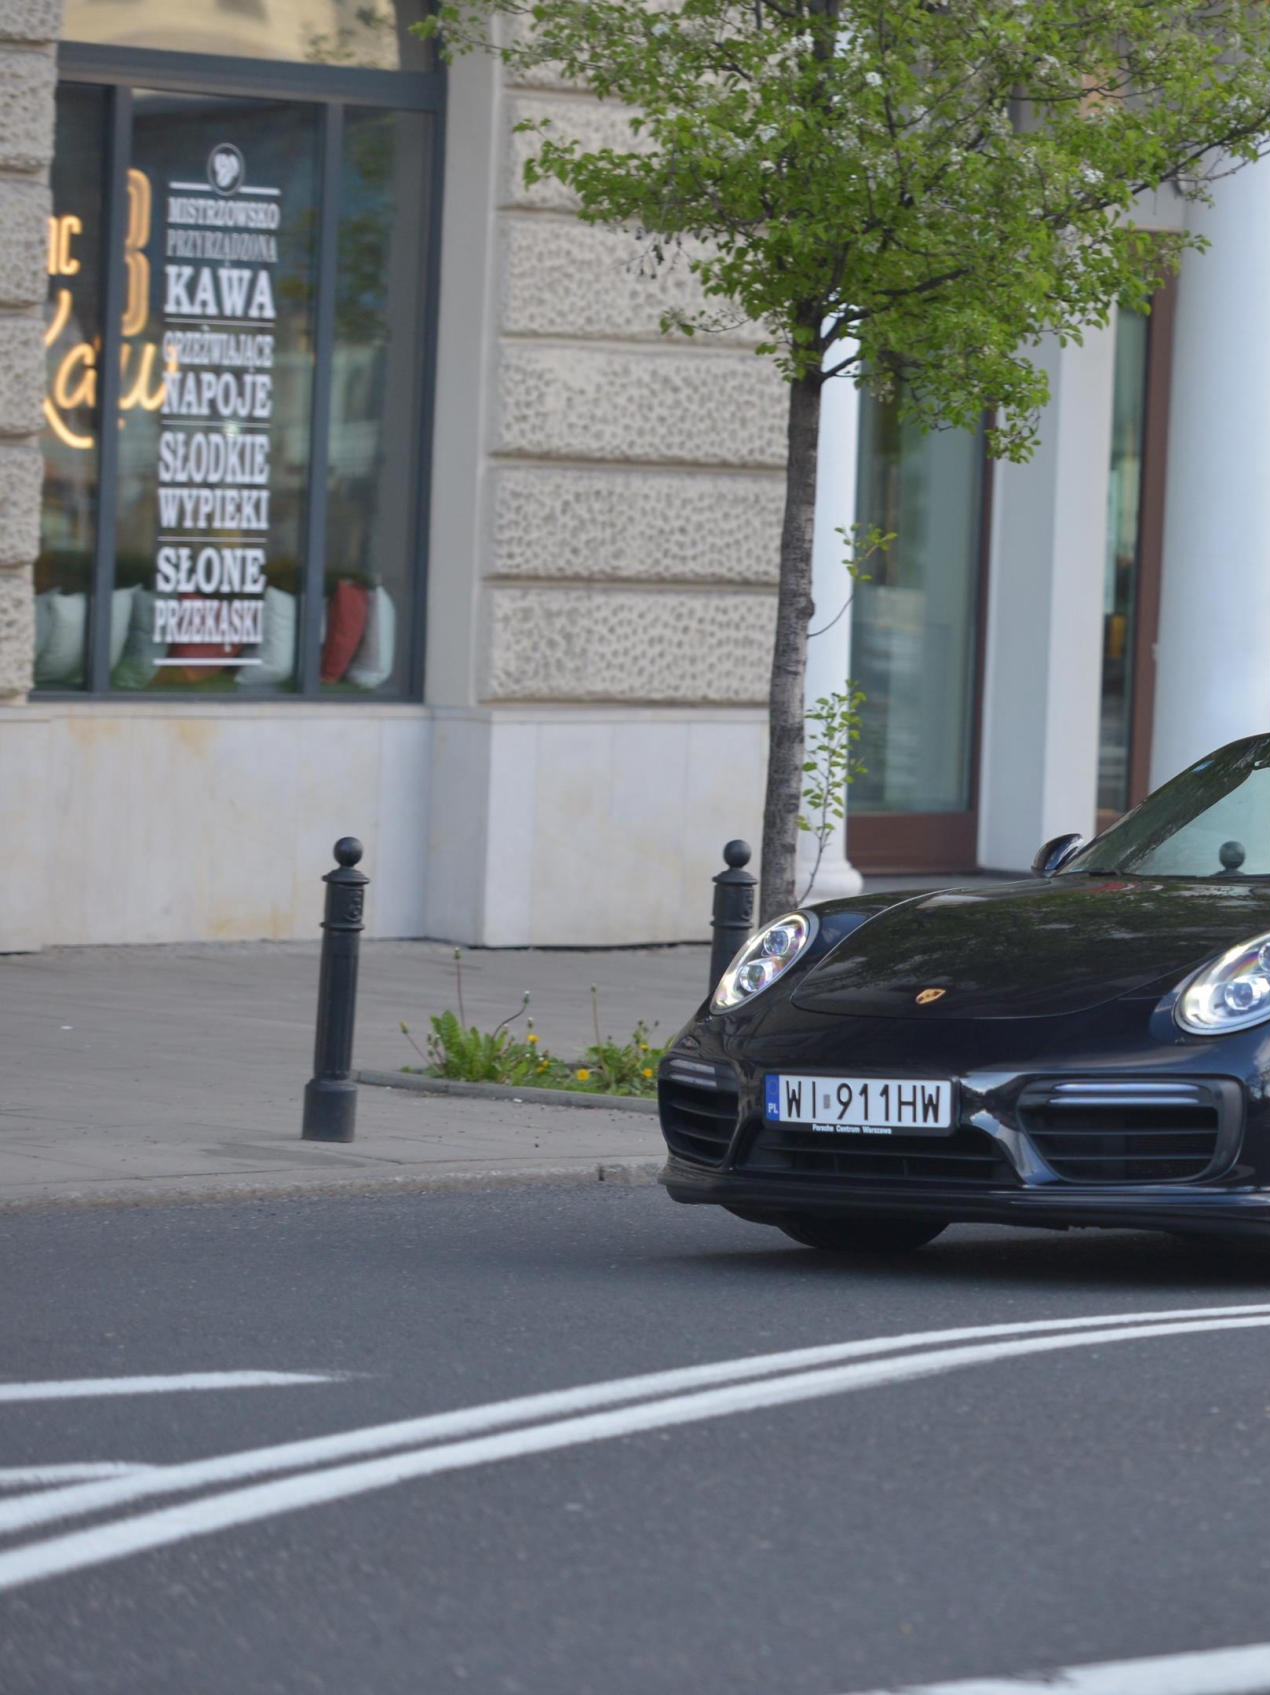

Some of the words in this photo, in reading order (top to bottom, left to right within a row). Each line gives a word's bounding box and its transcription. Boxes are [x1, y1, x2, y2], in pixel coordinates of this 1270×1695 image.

[167, 196, 281, 230] MISTRZOWSKO
[164, 264, 276, 319] KAWA
[160, 371, 273, 418] NAPOJE
[159, 431, 270, 486] SŁODKIE
[157, 487, 270, 531] WYPIEKI
[156, 546, 268, 594] SŁONE
[153, 598, 264, 653] PRZEKĄSKI
[768, 1102, 778, 1114] PL
[786, 1080, 816, 1119] WI
[836, 1082, 941, 1124] 911HW
[812, 1123, 834, 1133] Porsche
[836, 1124, 860, 1134] Centrum
[862, 1125, 892, 1135] Warszawa
